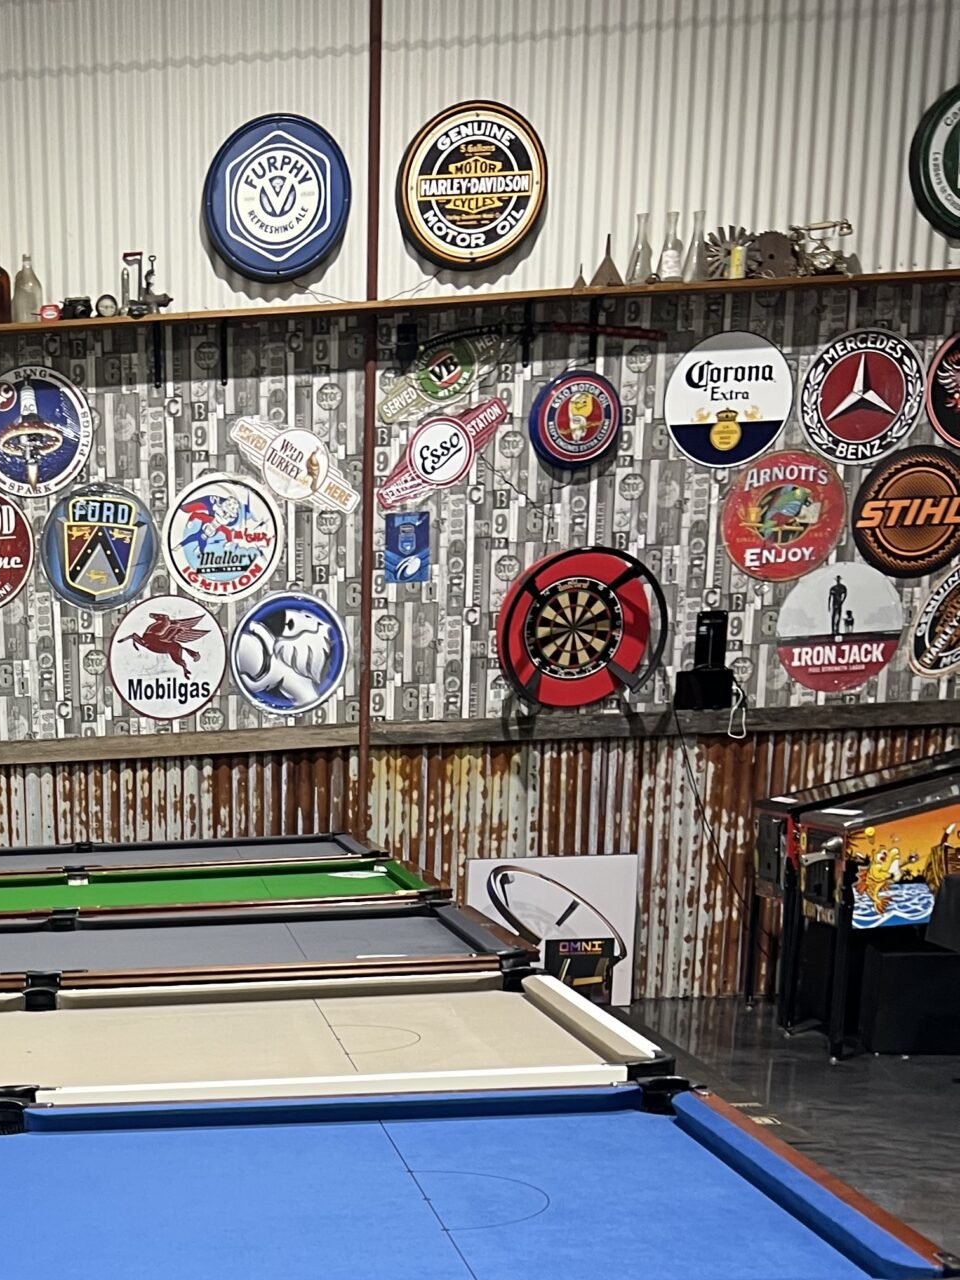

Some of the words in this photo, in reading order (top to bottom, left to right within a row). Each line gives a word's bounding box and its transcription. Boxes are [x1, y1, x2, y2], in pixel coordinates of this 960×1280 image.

[436, 122, 516, 150] GENUINE
[243, 155, 313, 190] FURPHY
[454, 160, 497, 175] MOTOR
[453, 196, 496, 210] CYCLES
[247, 209, 294, 235] REFRESHING
[295, 205, 309, 225] ALE
[423, 210, 487, 247] MOTOR
[496, 208, 525, 235] OIL
[821, 332, 905, 363] MERCEDES
[14, 368, 48, 380] RING
[685, 360, 777, 391] Corona
[381, 386, 419, 418] SERVED
[570, 383, 600, 396] MOTOR
[598, 394, 610, 409] OIL
[709, 386, 750, 402] Extra
[78, 410, 91, 457] PLUGS
[419, 431, 461, 475] Esso
[466, 402, 503, 437] STATION
[266, 446, 304, 480] TURKEY
[280, 438, 305, 464] WILD
[834, 440, 884, 460] BENZ
[7, 482, 52, 495] SPARK
[743, 464, 830, 492] ARNOTT'S
[323, 481, 353, 507] HERE
[73, 499, 131, 524] FORD
[855, 497, 960, 529] STIHL
[197, 550, 259, 566] Mallory
[181, 562, 264, 593] IGNITION
[791, 646, 838, 667] IRON
[838, 643, 885, 664] JACK
[128, 676, 211, 705] Mobilgas
[559, 940, 603, 952] OMNI
